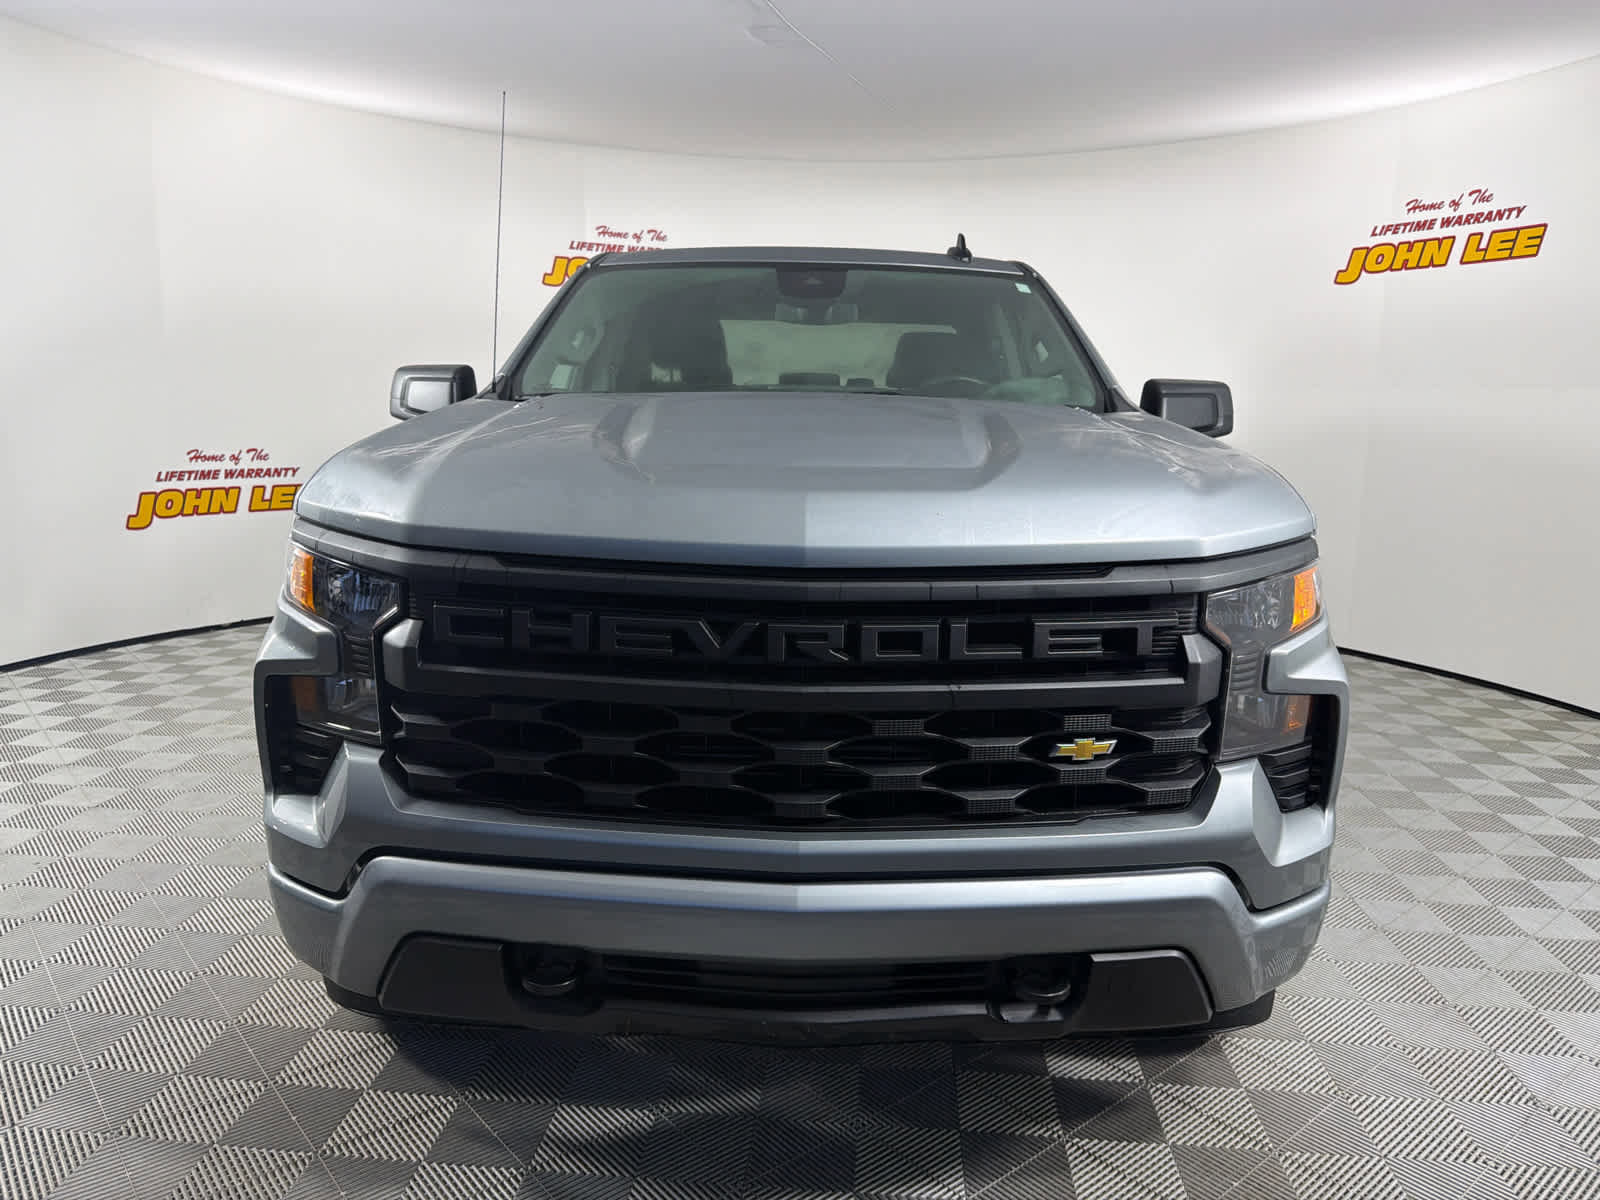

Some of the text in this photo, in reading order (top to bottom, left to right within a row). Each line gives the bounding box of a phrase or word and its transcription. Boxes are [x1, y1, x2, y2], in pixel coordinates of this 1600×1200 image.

[1405, 188, 1494, 214] Home of The
[595, 225, 667, 242] Home of The
[1370, 205, 1527, 238] LIFETIME WARRANTY
[568, 240, 625, 253] LIFETIME
[1334, 223, 1548, 285] JOHN LEE
[186, 448, 269, 465] Home of The
[155, 467, 300, 482] LIFETIME WARRANTY
[126, 484, 303, 530] JOHN LE
[432, 600, 1180, 664] CHEVROLET
